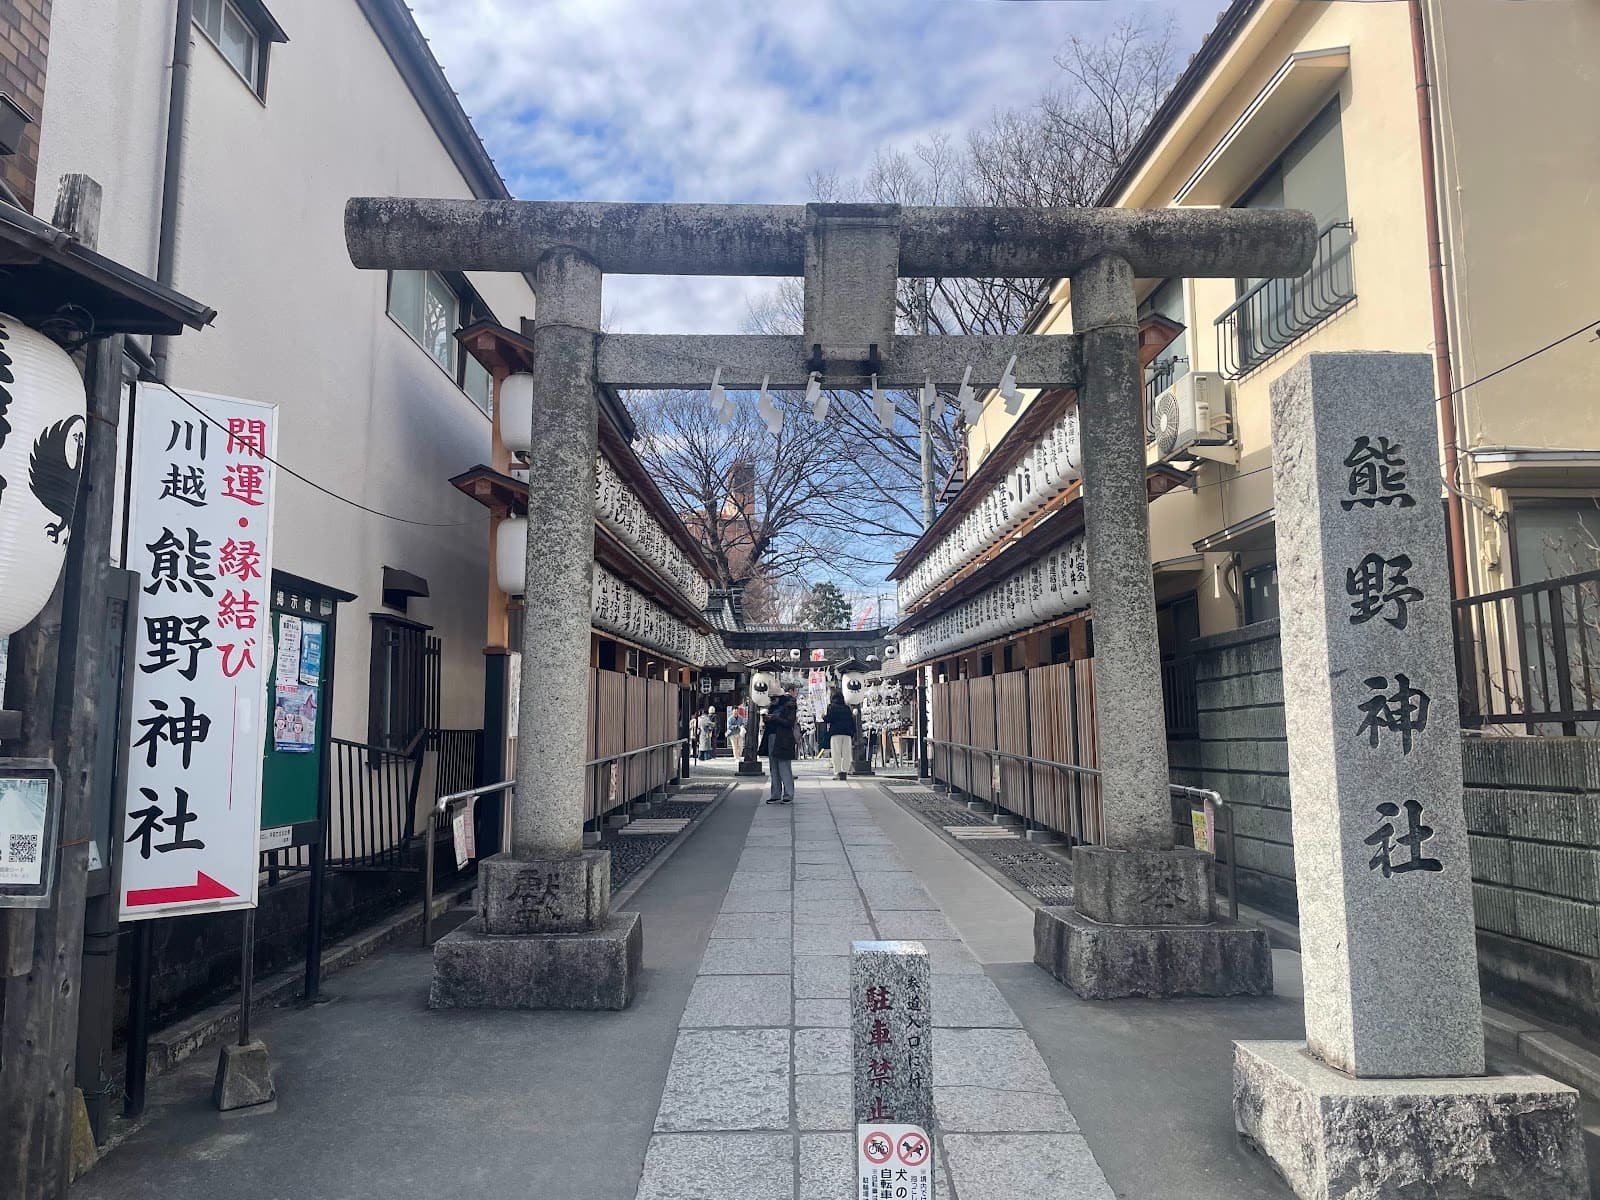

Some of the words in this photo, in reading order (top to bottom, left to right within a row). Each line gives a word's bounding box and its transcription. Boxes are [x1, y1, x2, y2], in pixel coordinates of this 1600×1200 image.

[159, 419, 207, 507] 川越
[217, 417, 267, 678] 開運・縁結び
[276, 590, 312, 613] 掲示板
[125, 526, 217, 860] 熊野神社
[1339, 435, 1444, 879] 熊野神社
[865, 985, 895, 1122] 駐車禁止
[880, 1168, 893, 1199] 自転車
[895, 1168, 908, 1199] 犬の
